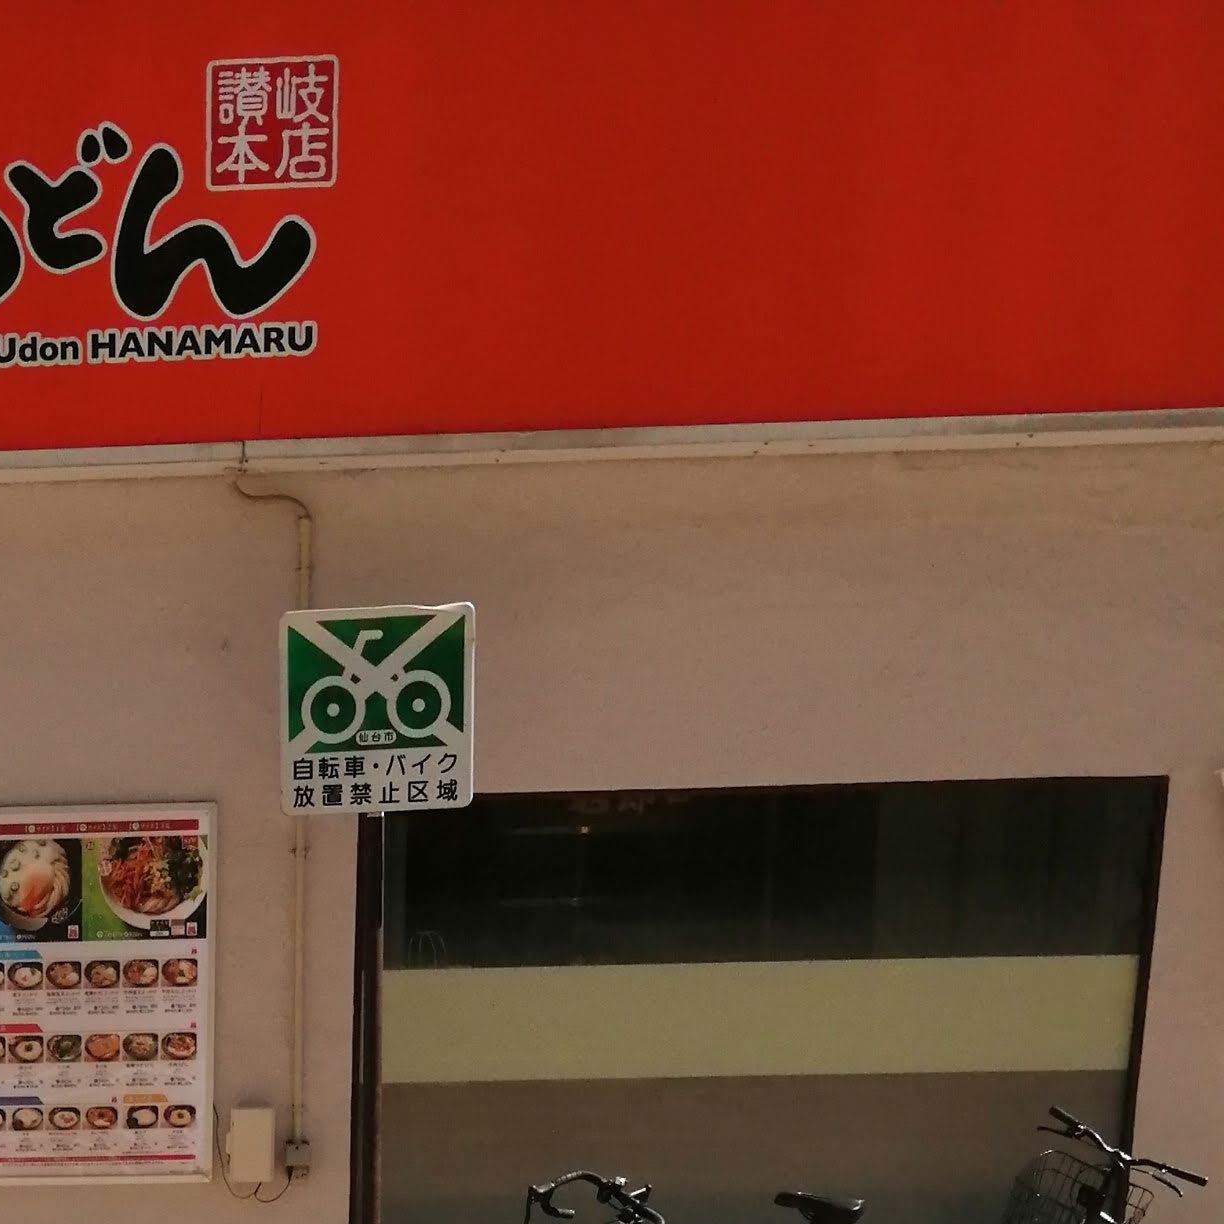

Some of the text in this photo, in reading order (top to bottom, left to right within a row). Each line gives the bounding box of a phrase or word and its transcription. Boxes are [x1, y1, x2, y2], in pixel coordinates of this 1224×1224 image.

[216, 123, 327, 183] 本店
[90, 323, 315, 359] HANAMARU
[358, 730, 394, 743] 仙台市
[293, 752, 458, 780] 自転車・バイク
[293, 778, 458, 808] 放置禁止区域
